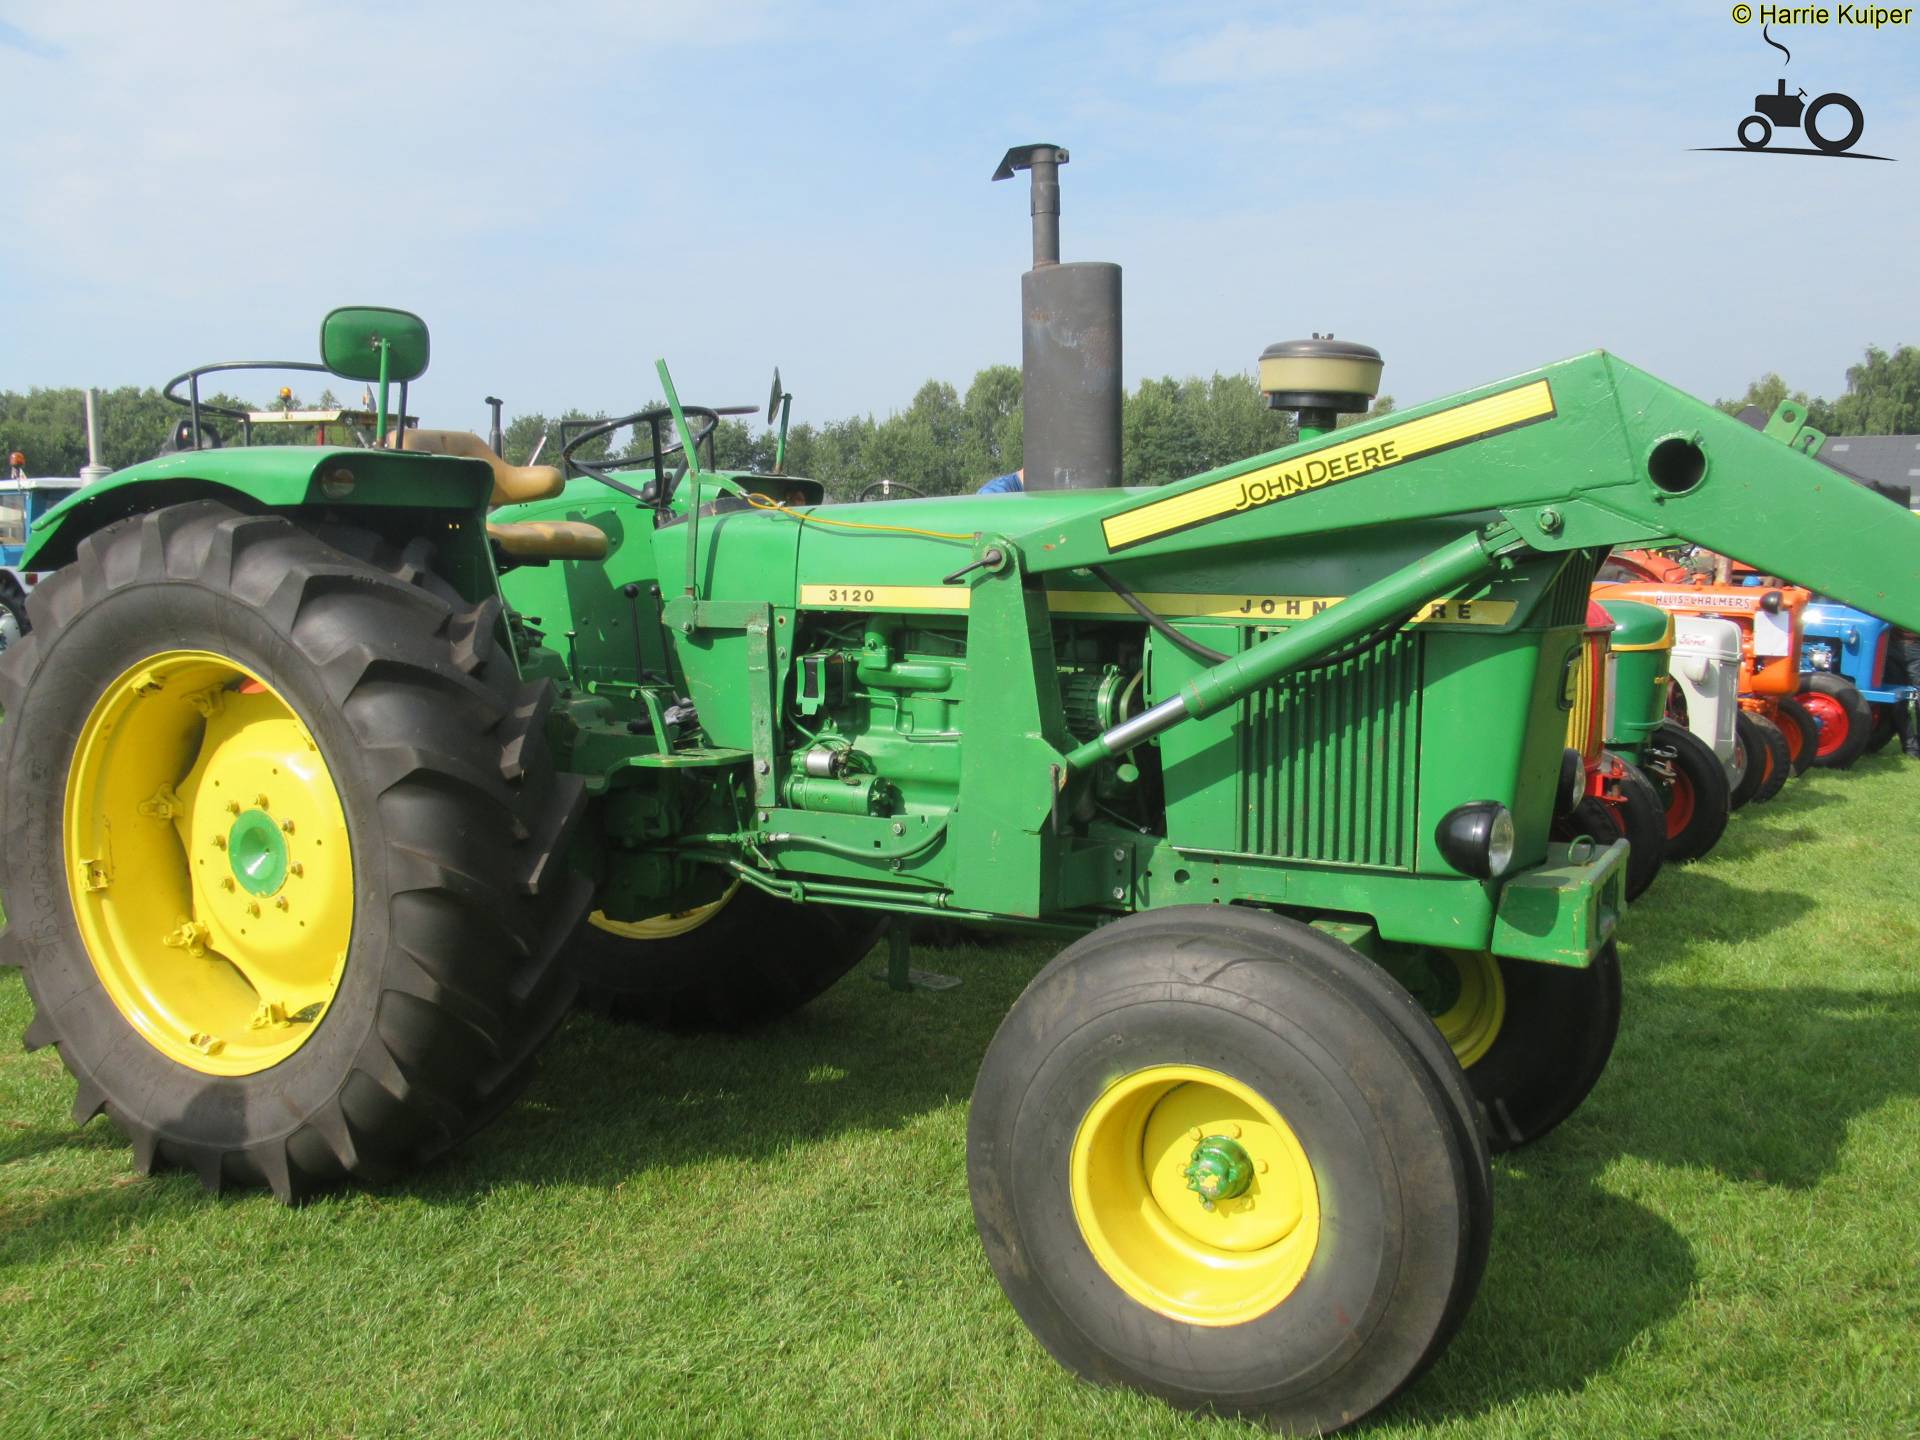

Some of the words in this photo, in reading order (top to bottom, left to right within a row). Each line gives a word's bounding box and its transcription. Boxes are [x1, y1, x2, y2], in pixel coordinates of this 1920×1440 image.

[1236, 468, 1304, 508] JOHN
[1306, 441, 1398, 485] DEERE
[829, 589, 874, 602] 3120
[1240, 599, 1327, 616] JOHN
